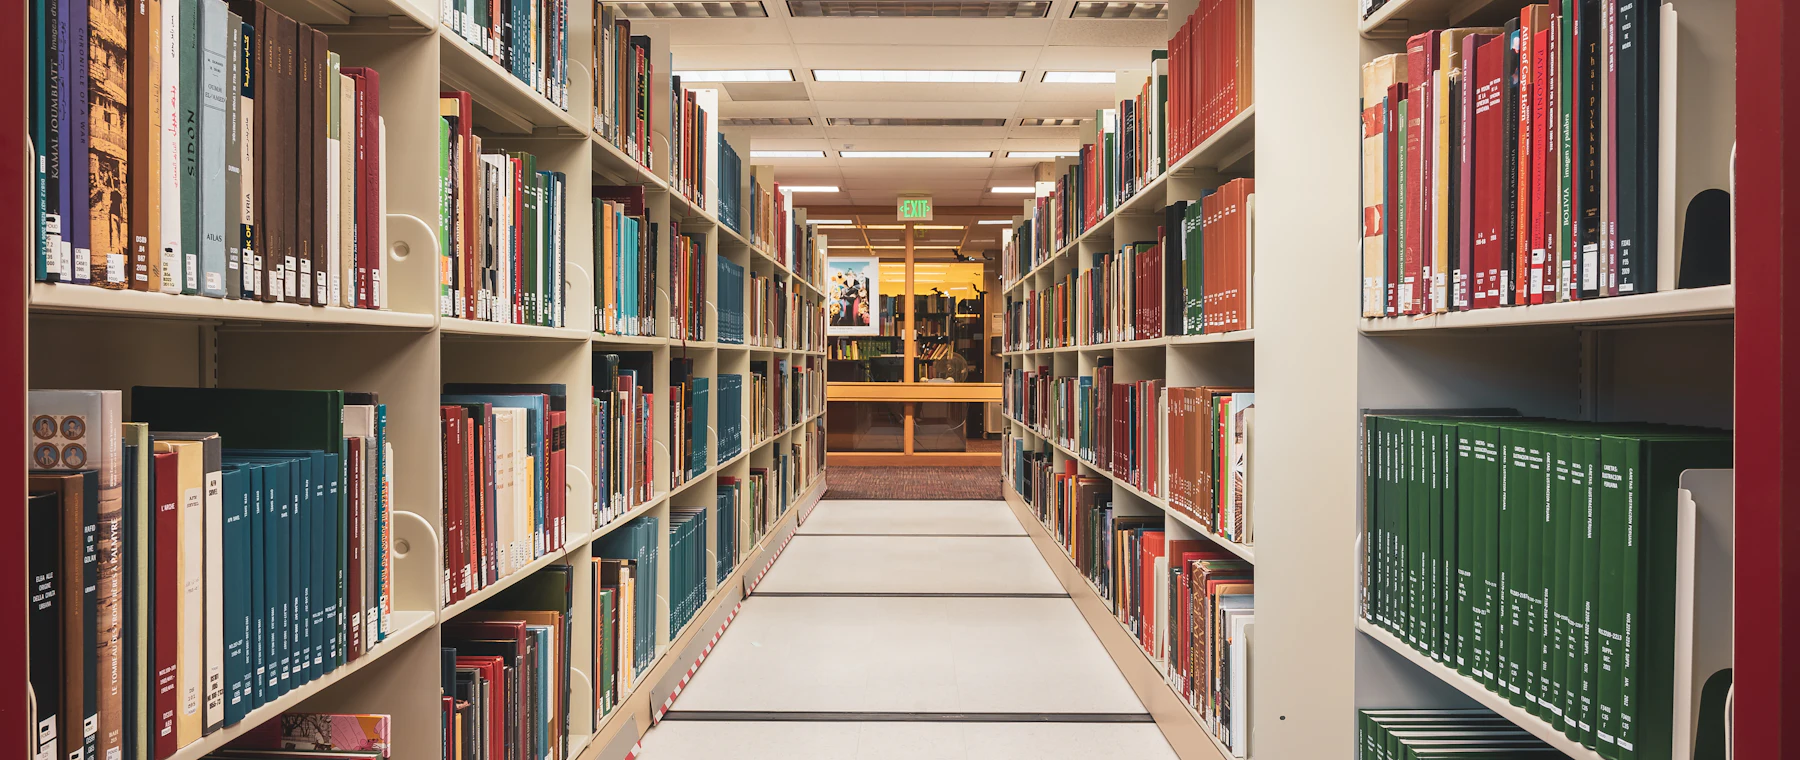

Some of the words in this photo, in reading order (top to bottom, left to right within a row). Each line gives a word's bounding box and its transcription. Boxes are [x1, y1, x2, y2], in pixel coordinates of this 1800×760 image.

[1522, 53, 1528, 63] of
[80, 91, 85, 104] OF
[904, 200, 927, 217] EXIT
[1511, 200, 1514, 209] DE
[246, 225, 251, 238] OF
[207, 233, 222, 242] ATLAS
[112, 686, 117, 695] LE
